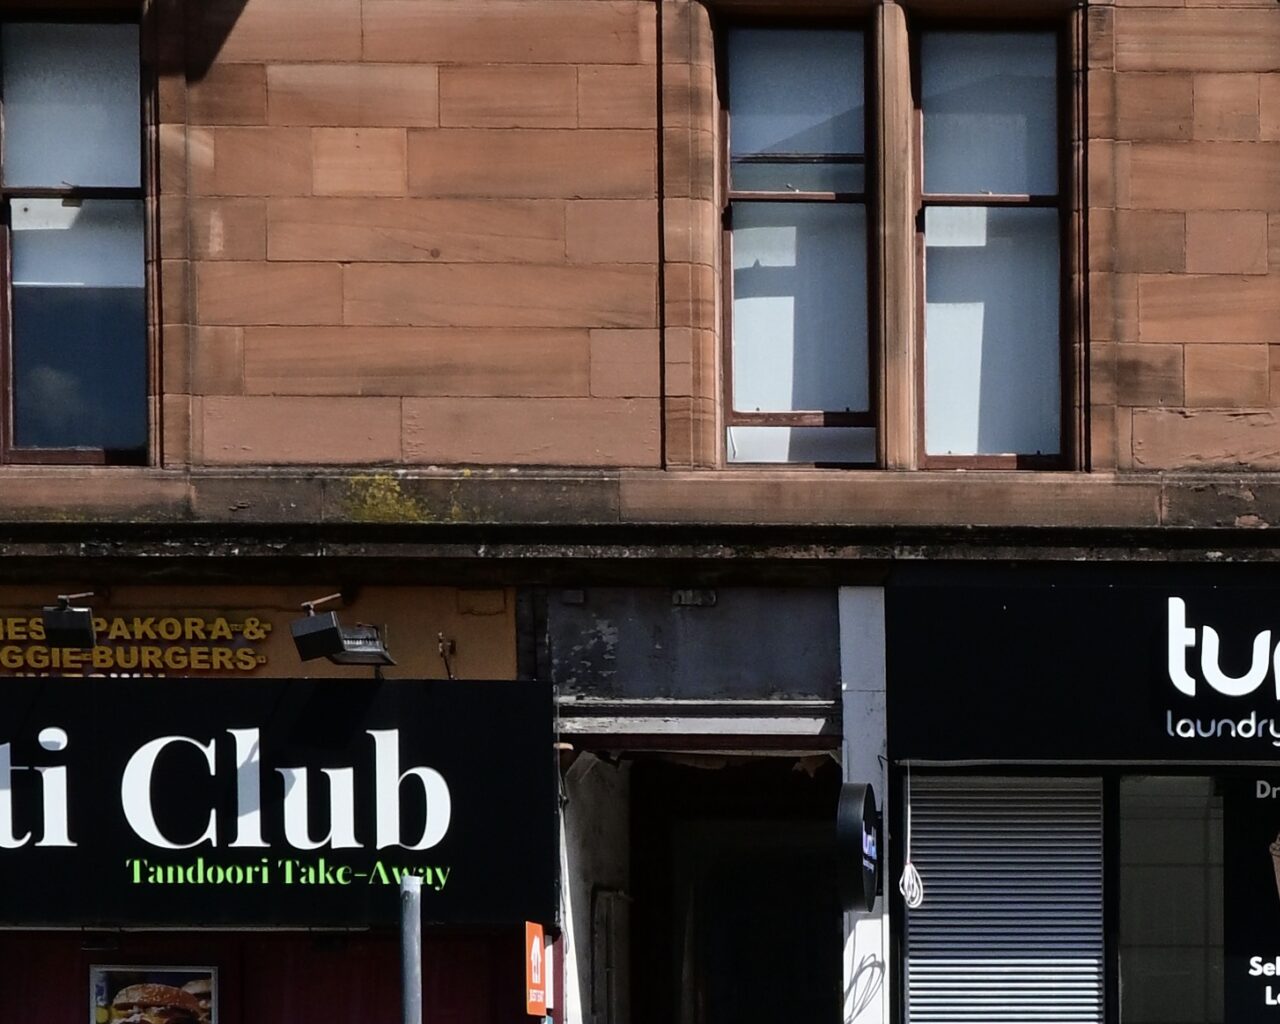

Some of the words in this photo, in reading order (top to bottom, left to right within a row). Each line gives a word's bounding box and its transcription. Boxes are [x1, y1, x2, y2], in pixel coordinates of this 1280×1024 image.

[92, 617, 233, 640] PAKORA
[92, 646, 258, 670] BURGERS
[121, 727, 452, 850] Club
[126, 856, 270, 885] Tandoori
